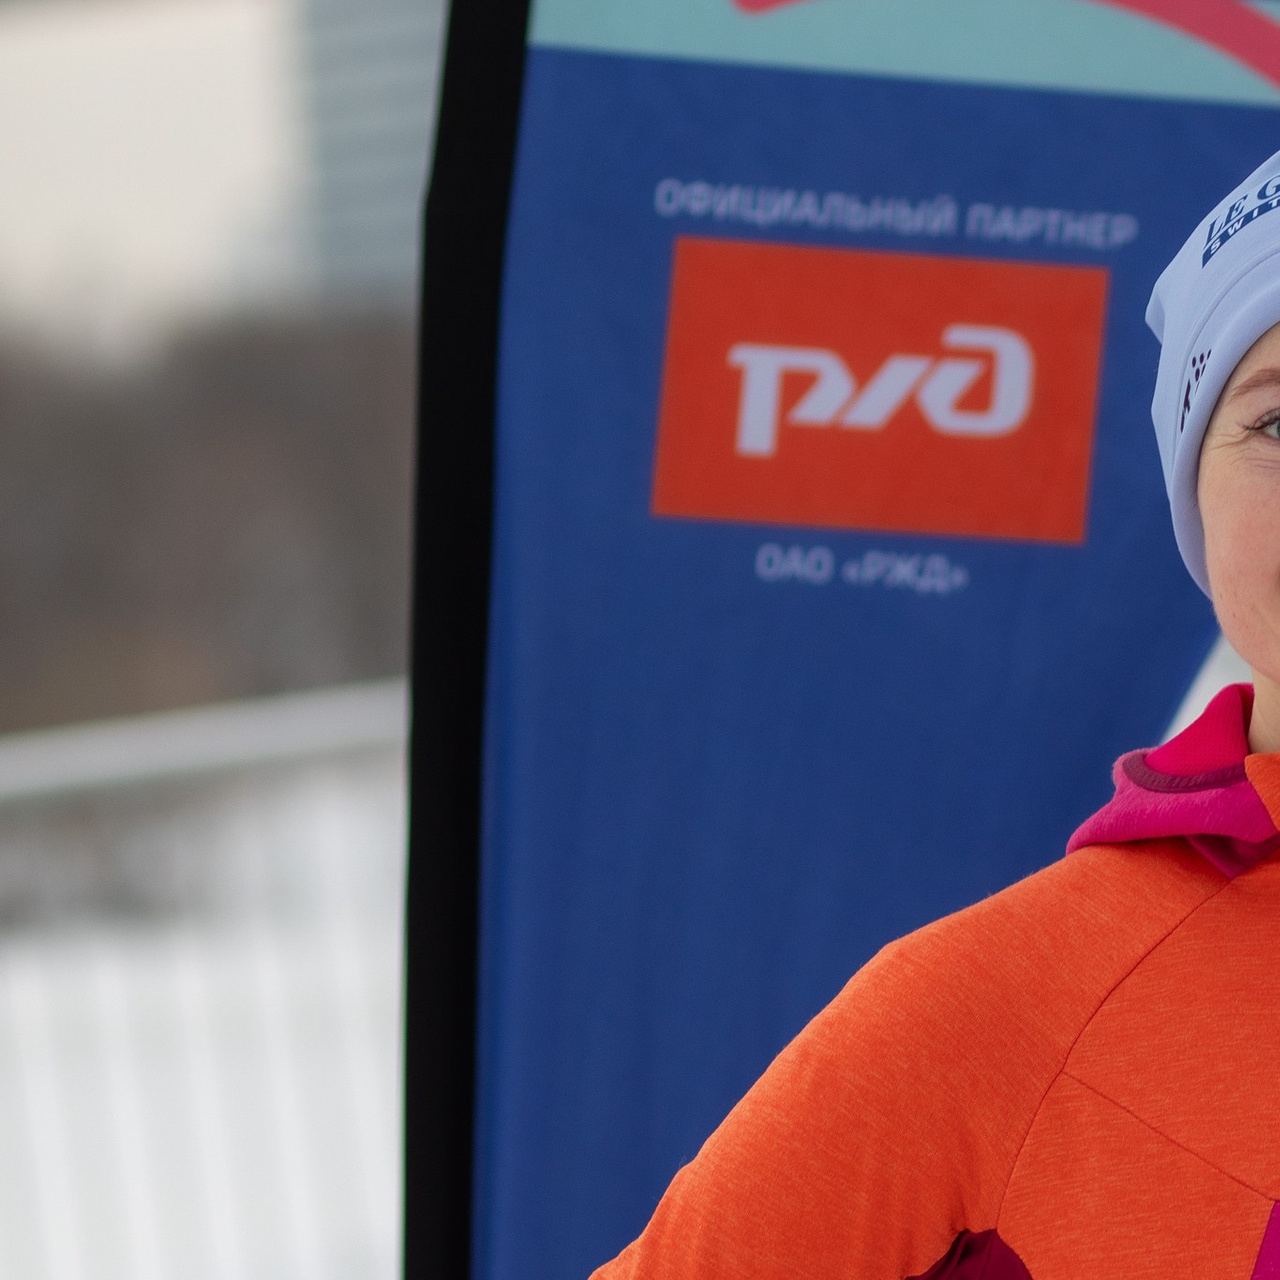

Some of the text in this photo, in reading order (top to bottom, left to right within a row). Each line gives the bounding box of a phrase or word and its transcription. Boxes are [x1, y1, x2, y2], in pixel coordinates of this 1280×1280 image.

[654, 177, 1139, 249] ОФИЦИАЛЬНЫЙ ПАРТНЕР
[1203, 194, 1249, 250] LE
[754, 541, 836, 587] ОАО
